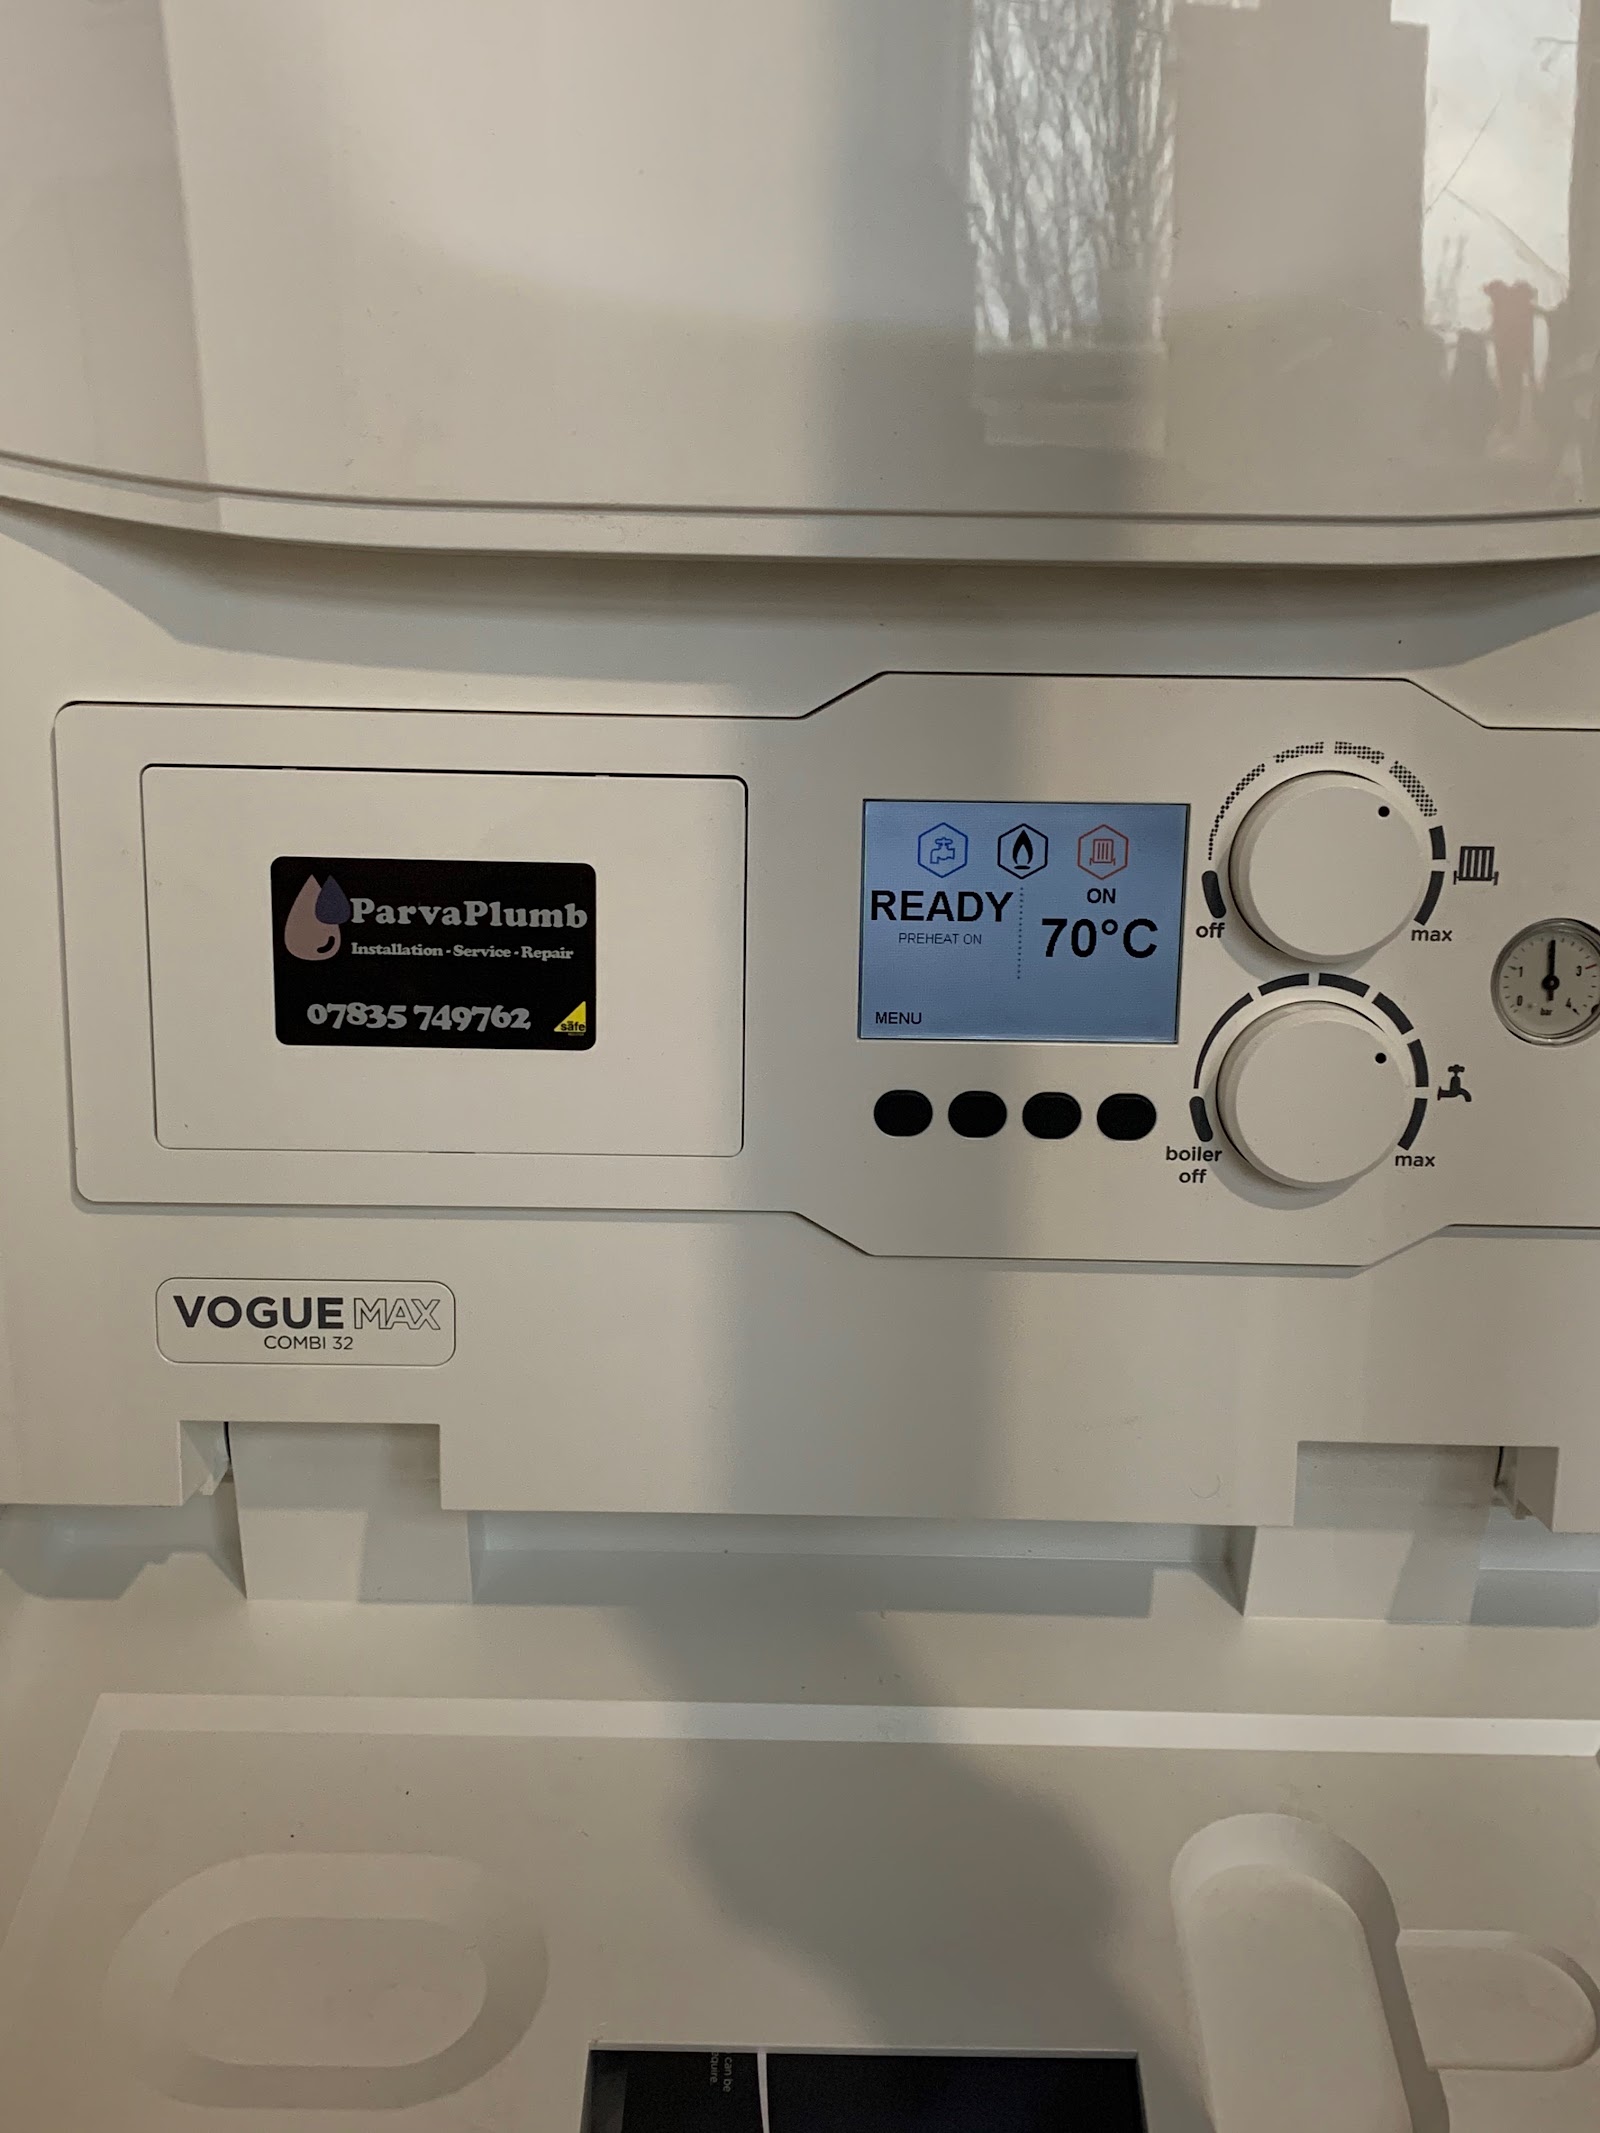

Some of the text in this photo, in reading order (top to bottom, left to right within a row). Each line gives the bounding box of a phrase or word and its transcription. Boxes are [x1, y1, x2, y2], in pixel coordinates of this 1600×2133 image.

[1086, 888, 1117, 904] ON
[350, 897, 588, 928] ParvaPlumb
[870, 889, 1014, 922] READY
[898, 932, 983, 945] PREHEAT ON
[1041, 917, 1158, 958] 70°C
[1195, 922, 1226, 939] off
[1411, 929, 1453, 943] max
[350, 942, 444, 957] Installation
[453, 944, 511, 959] Service
[521, 946, 574, 962] Repair
[1576, 965, 1582, 977] 3
[306, 1002, 532, 1032] 07835 749762
[875, 1011, 922, 1025] MENU
[1165, 1146, 1223, 1163] boiler
[1394, 1155, 1436, 1168] max
[1178, 1169, 1207, 1184] off
[172, 1295, 441, 1331] VOGUE MAX
[263, 1335, 354, 1351] COMBI 32
[722, 2056, 733, 2093] can be
